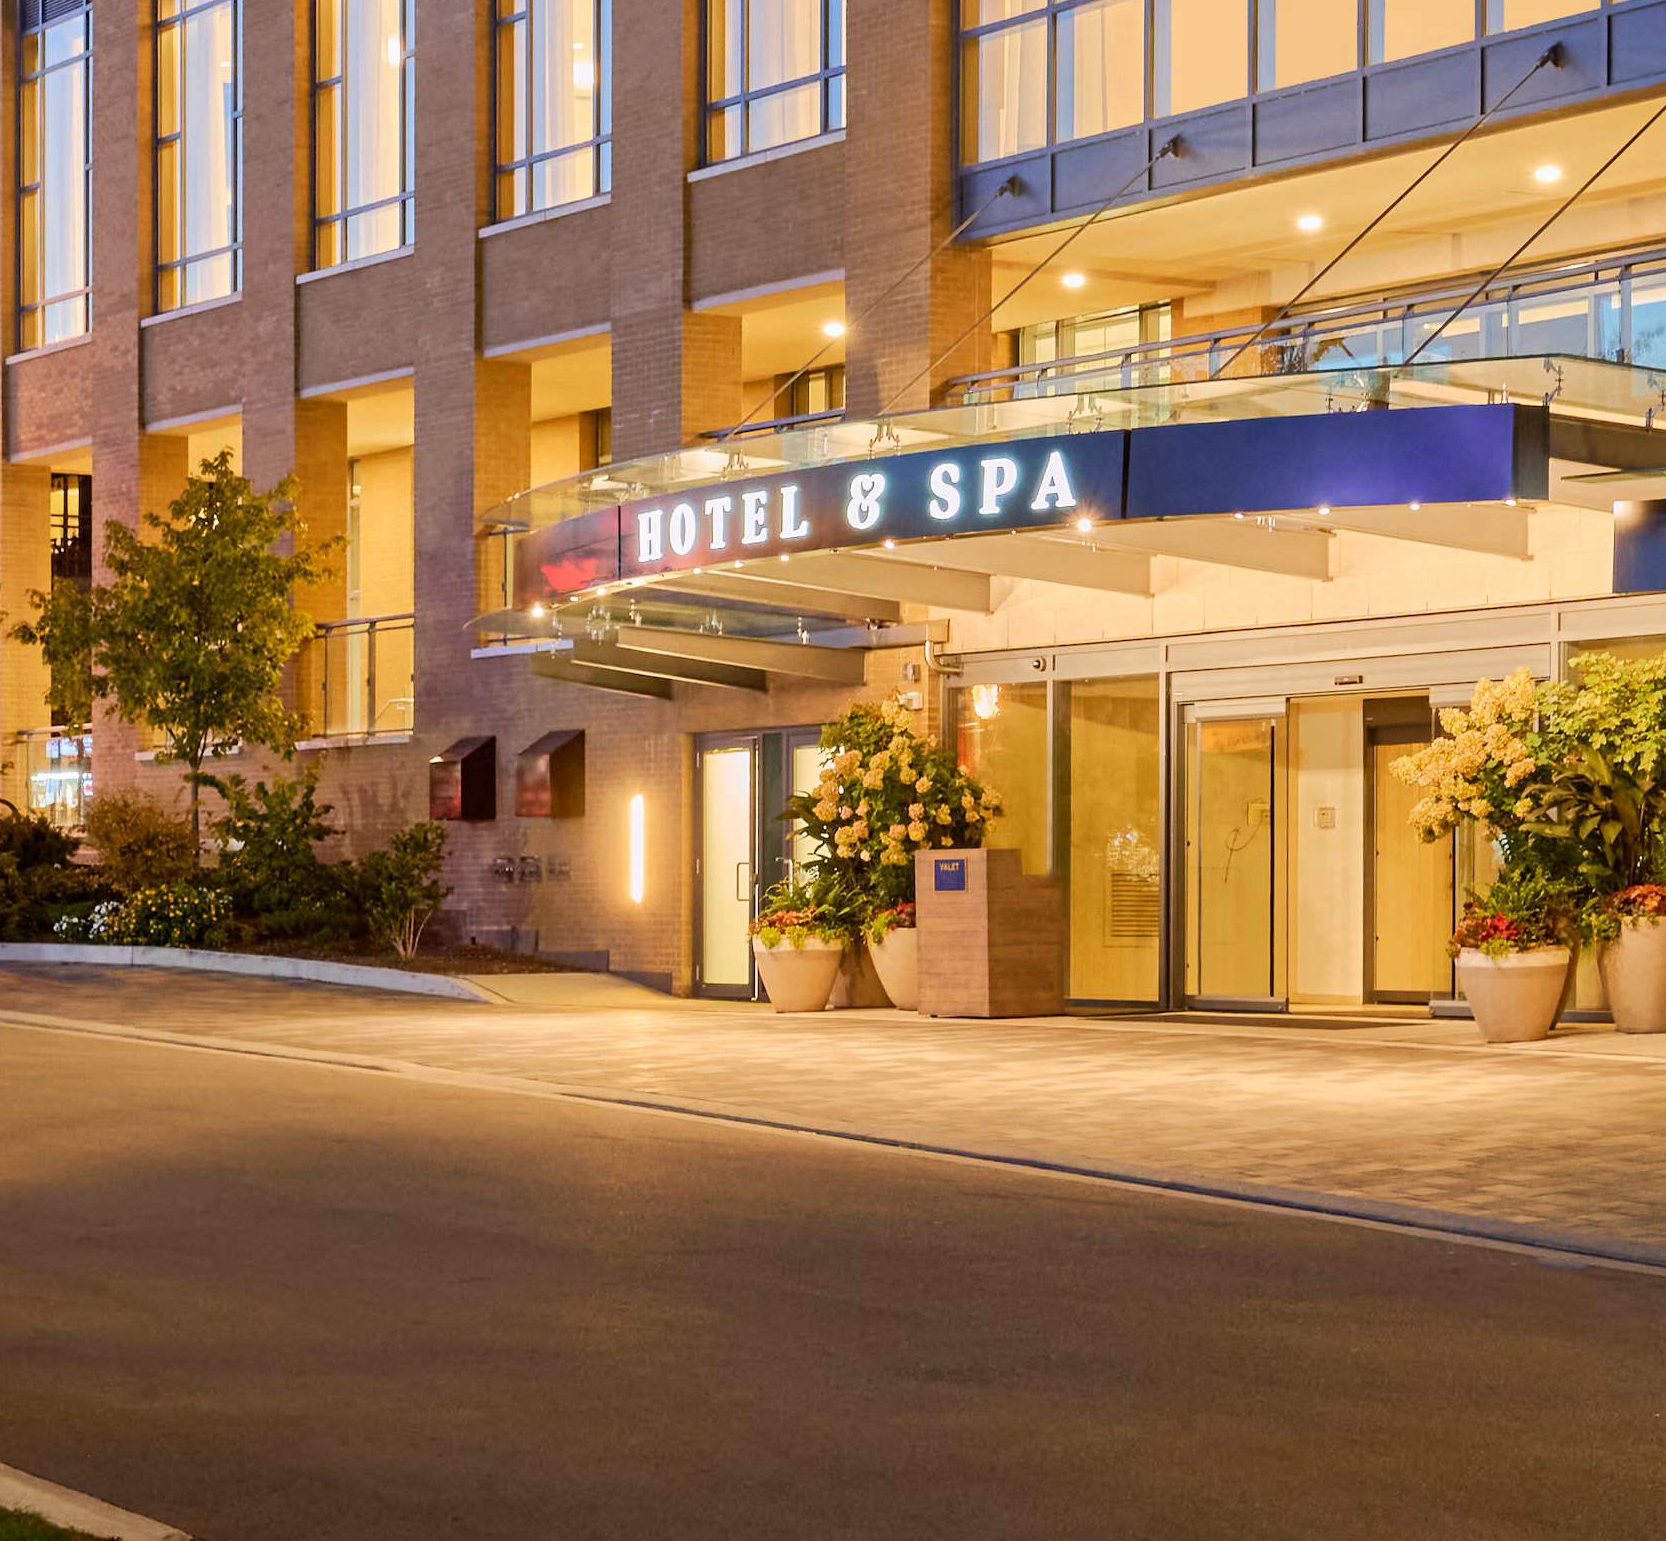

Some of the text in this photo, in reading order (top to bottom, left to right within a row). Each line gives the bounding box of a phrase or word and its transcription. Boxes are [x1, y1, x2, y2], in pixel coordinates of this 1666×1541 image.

[636, 450, 1078, 564] HOTEL & SPA
[939, 862, 960, 872] VALET
